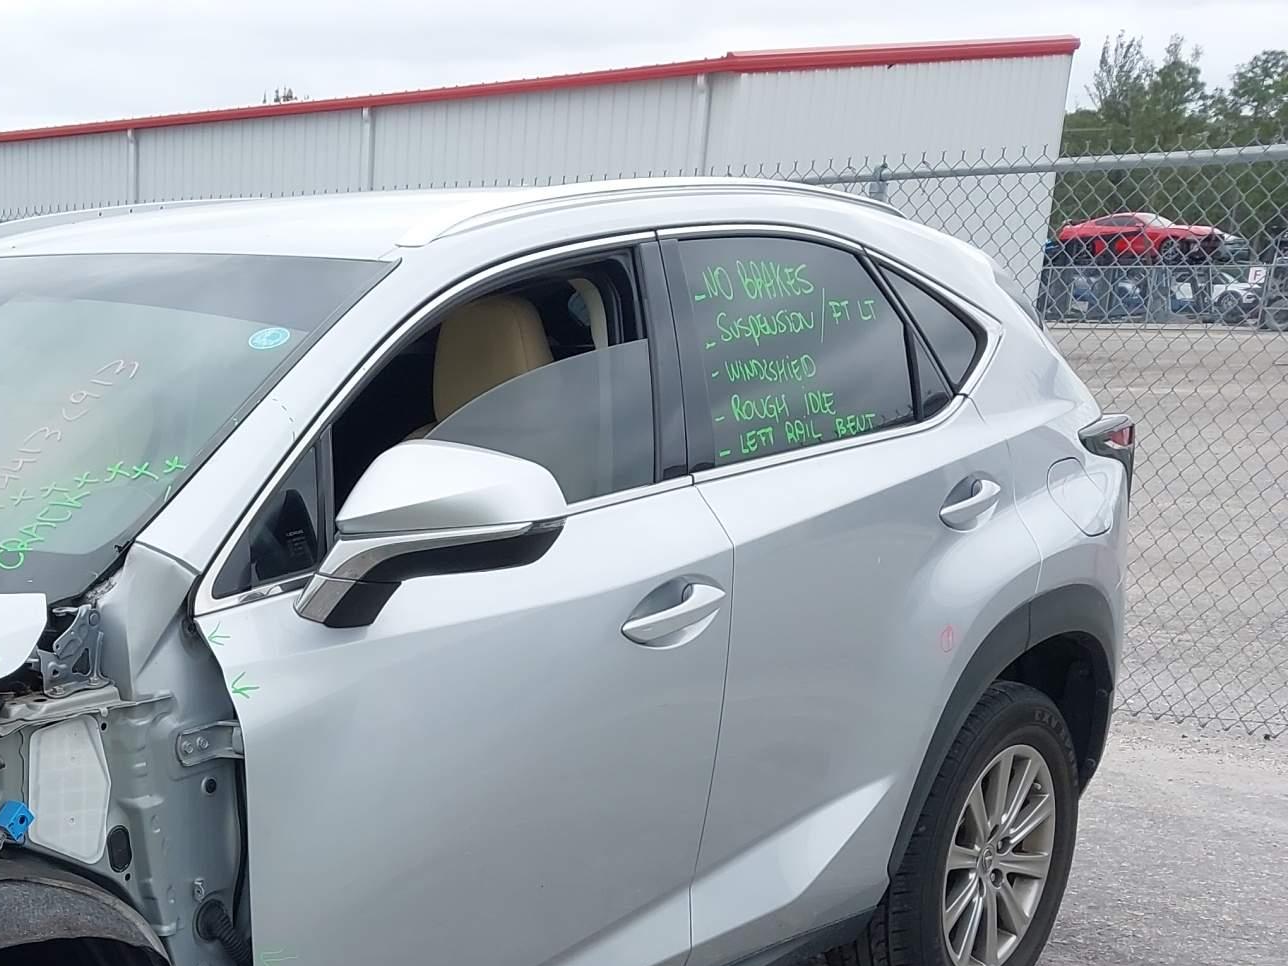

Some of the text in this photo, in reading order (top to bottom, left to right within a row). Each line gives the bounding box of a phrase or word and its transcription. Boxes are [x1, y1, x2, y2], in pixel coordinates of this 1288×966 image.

[736, 260, 814, 299] BRAKES
[829, 301, 850, 325] FT
[857, 300, 876, 320] LT
[732, 394, 790, 423] ROUGH
[802, 388, 836, 417] IDLE
[740, 426, 774, 454] LEFT
[785, 419, 822, 444] RAIL
[835, 413, 876, 438] BENT
